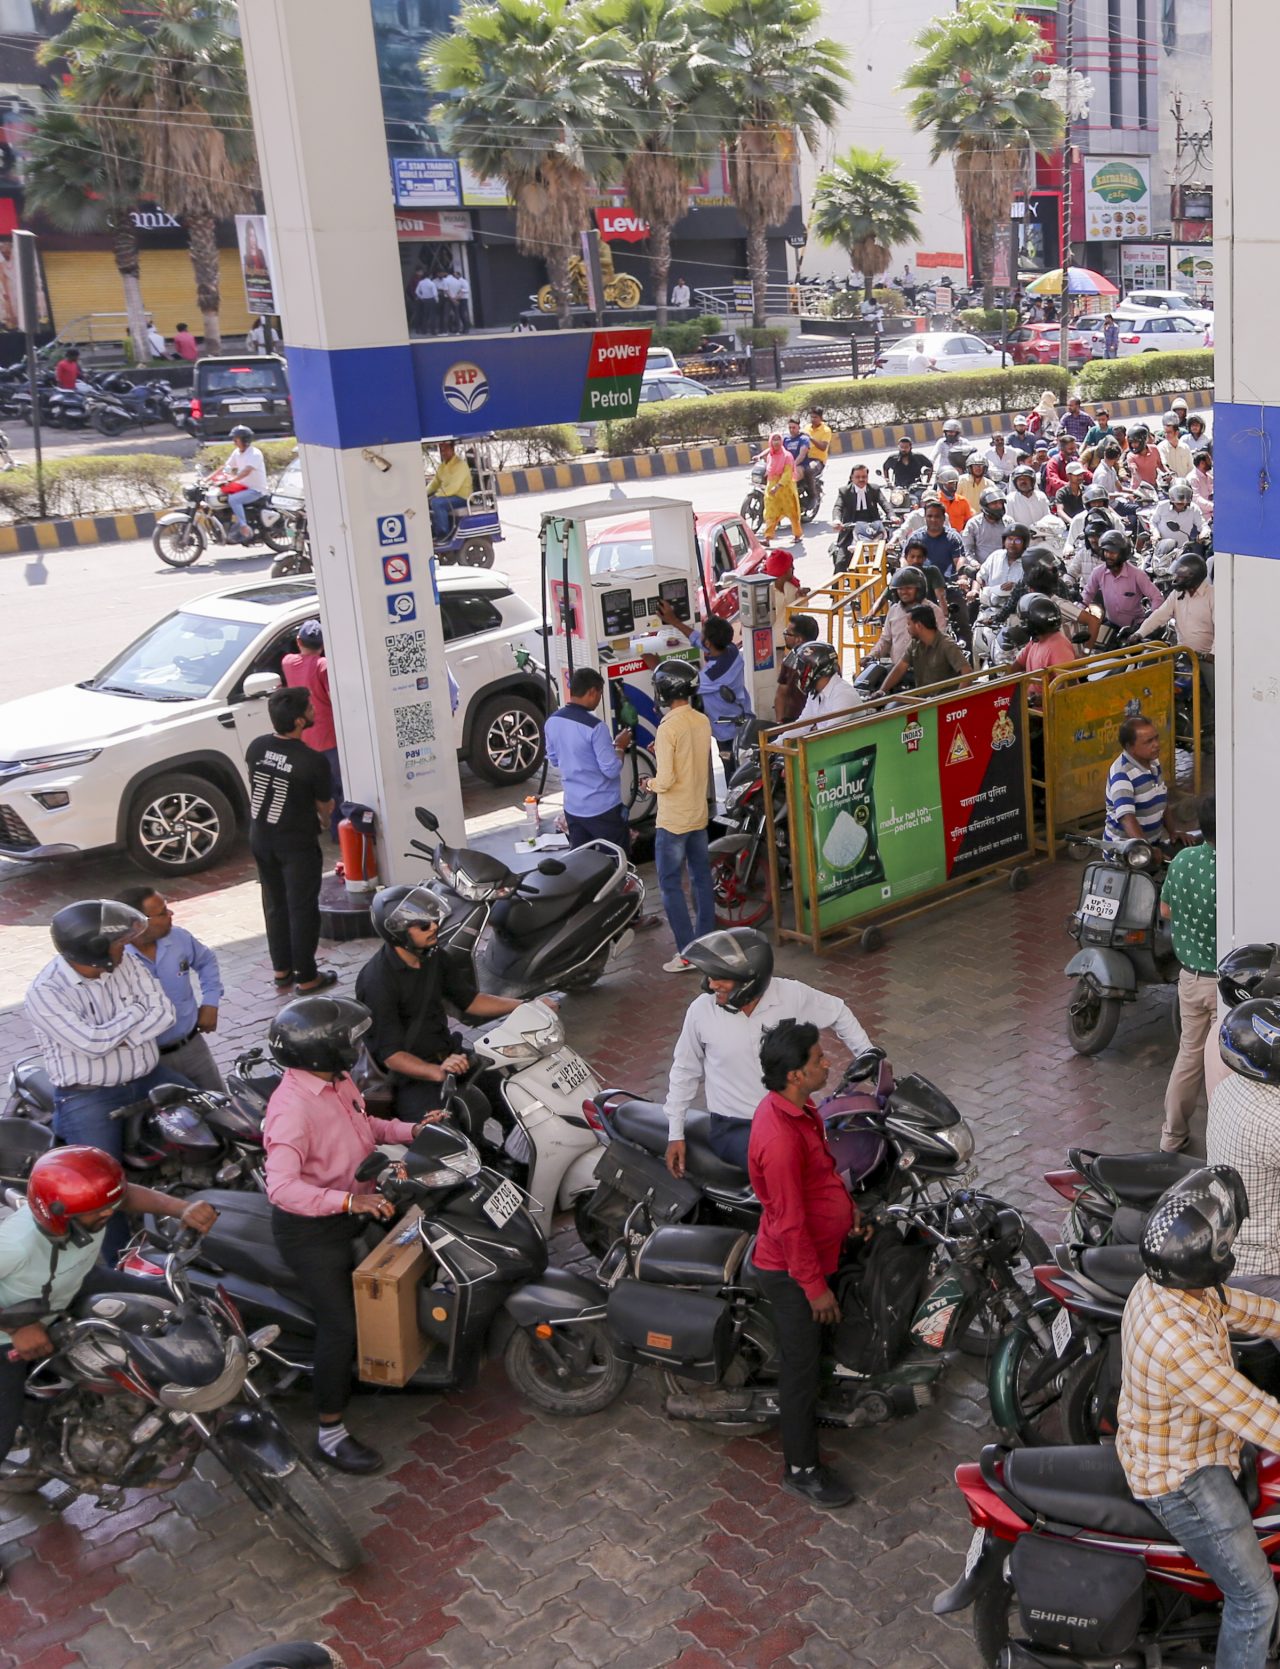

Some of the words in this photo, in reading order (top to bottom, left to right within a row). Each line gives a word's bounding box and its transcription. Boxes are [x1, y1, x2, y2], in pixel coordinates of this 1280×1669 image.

[454, 368, 478, 386] HP
[590, 387, 633, 409] Petrol
[946, 708, 968, 723] STOP
[816, 765, 866, 806] madhur
[987, 785, 1008, 802] पुलिस
[880, 806, 904, 829] madhur
[905, 810, 915, 820] hai
[894, 818, 920, 835] perfect
[950, 826, 968, 842] पुलिस
[926, 1297, 948, 1312] TVS
